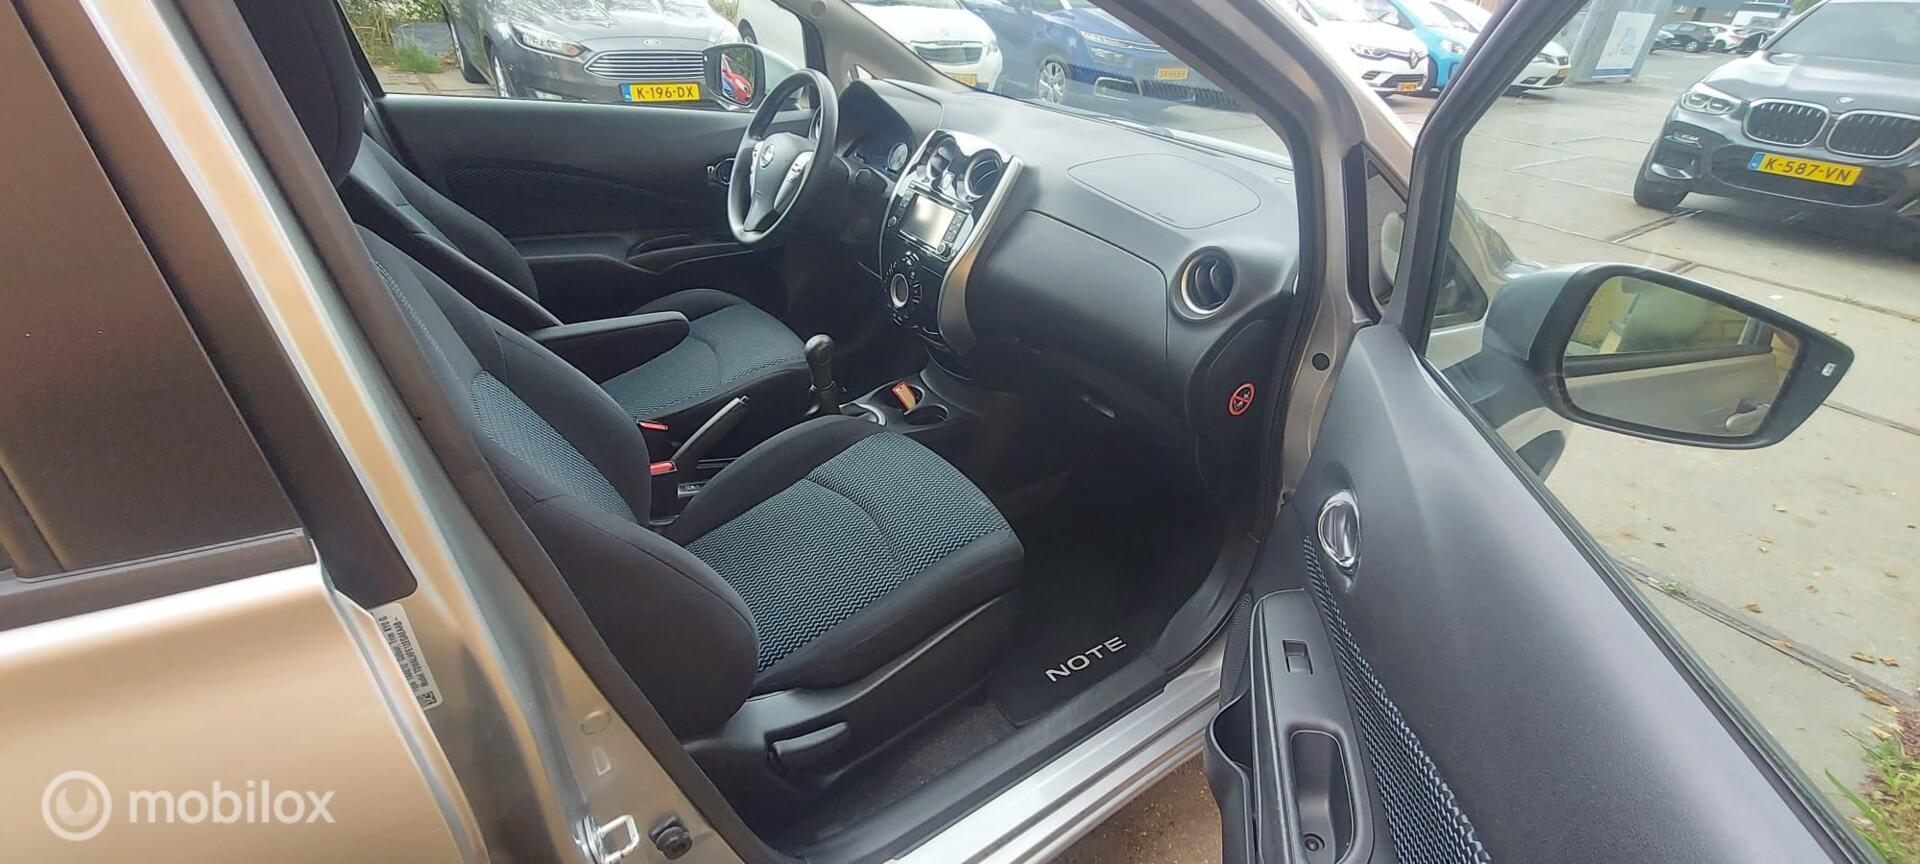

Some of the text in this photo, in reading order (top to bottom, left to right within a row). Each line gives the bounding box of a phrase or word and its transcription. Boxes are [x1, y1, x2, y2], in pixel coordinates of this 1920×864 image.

[637, 86, 695, 99] K-196-DX
[1764, 157, 1852, 183] K-587-VN
[1045, 636, 1127, 682] NOTE
